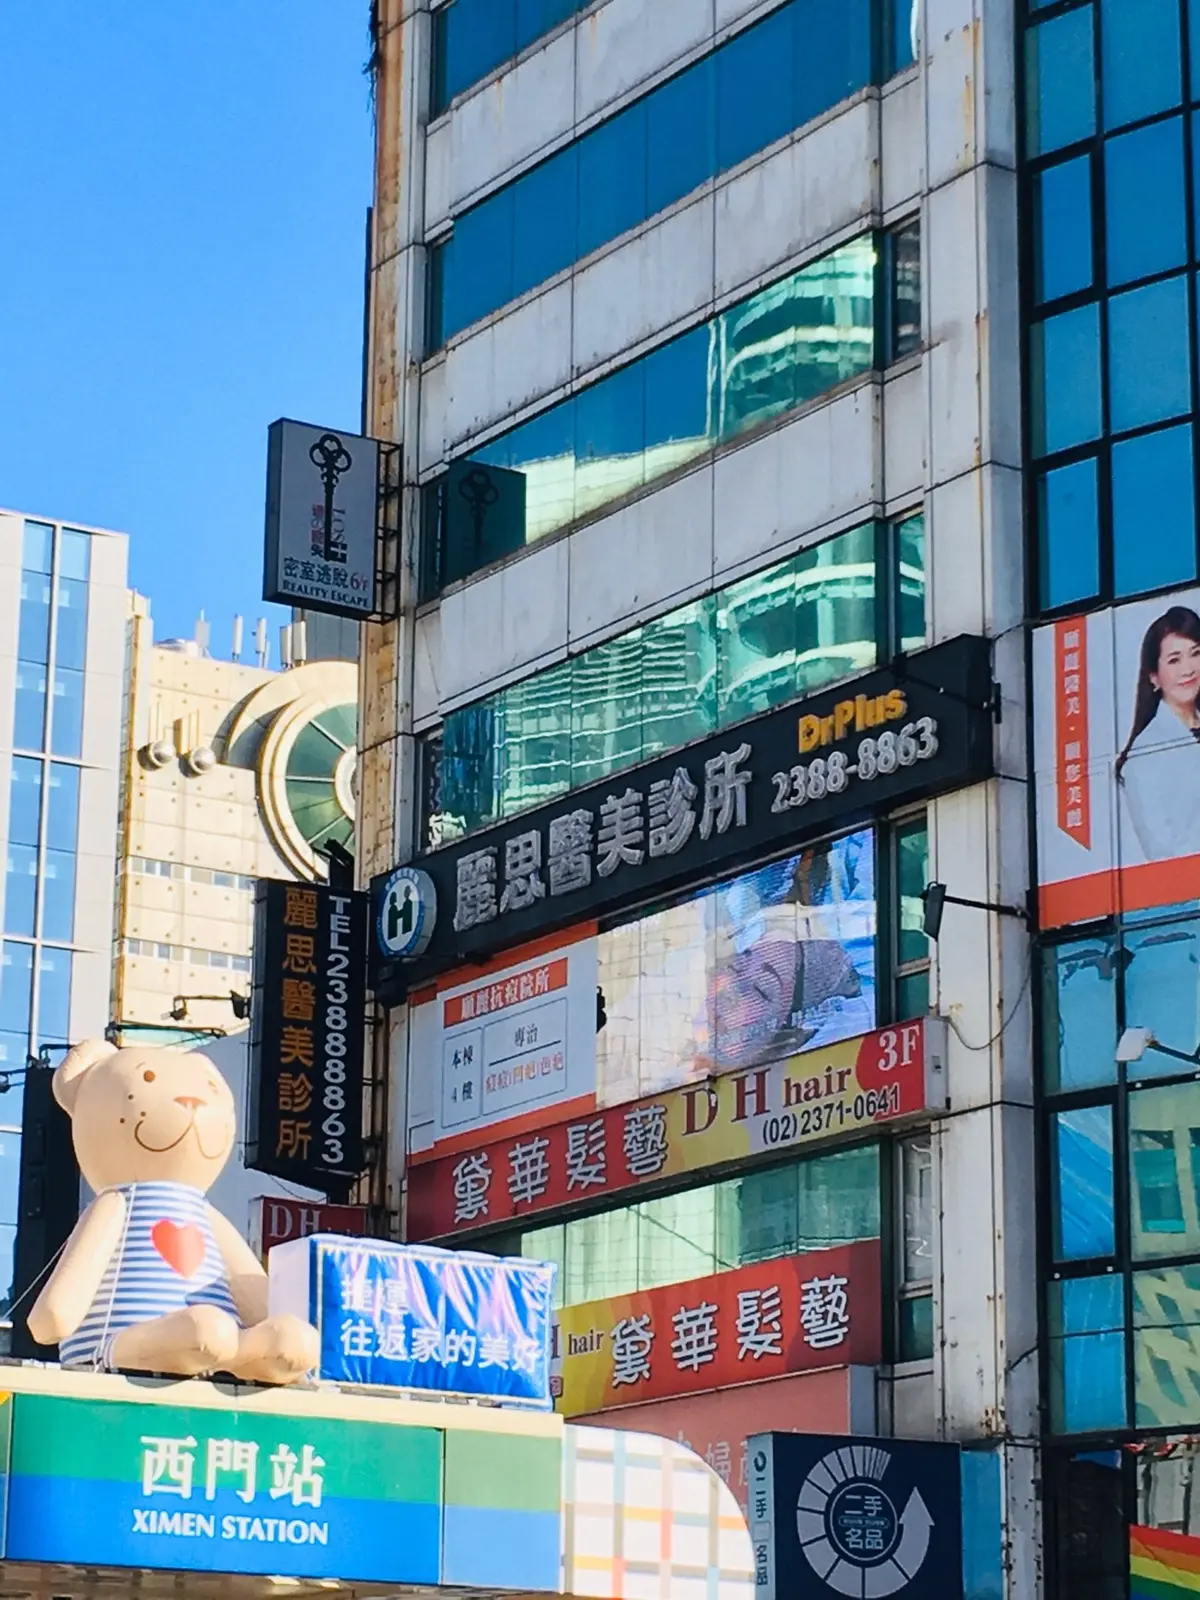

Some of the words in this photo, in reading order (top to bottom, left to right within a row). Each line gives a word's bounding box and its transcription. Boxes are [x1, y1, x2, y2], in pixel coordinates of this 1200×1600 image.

[283, 579, 327, 598] REALITY
[331, 590, 369, 607] ESCAPE
[771, 717, 939, 813] 2388-8863
[453, 743, 752, 932] 麗思醫美診所
[275, 886, 319, 1161] 麗思醫美診所
[879, 1024, 920, 1071] 3F
[783, 1065, 852, 1109] hair
[452, 1104, 669, 1225] 黛華髮藝
[340, 1318, 541, 1374] 往返家的美好
[567, 1328, 605, 1356] hair
[610, 1274, 850, 1389] 黛華髮藝
[140, 1434, 326, 1508] 西門站
[132, 1508, 215, 1538] XIMEN
[222, 1514, 328, 1545] STATION
[844, 1494, 883, 1517] 二手
[844, 1527, 884, 1550] 名品
